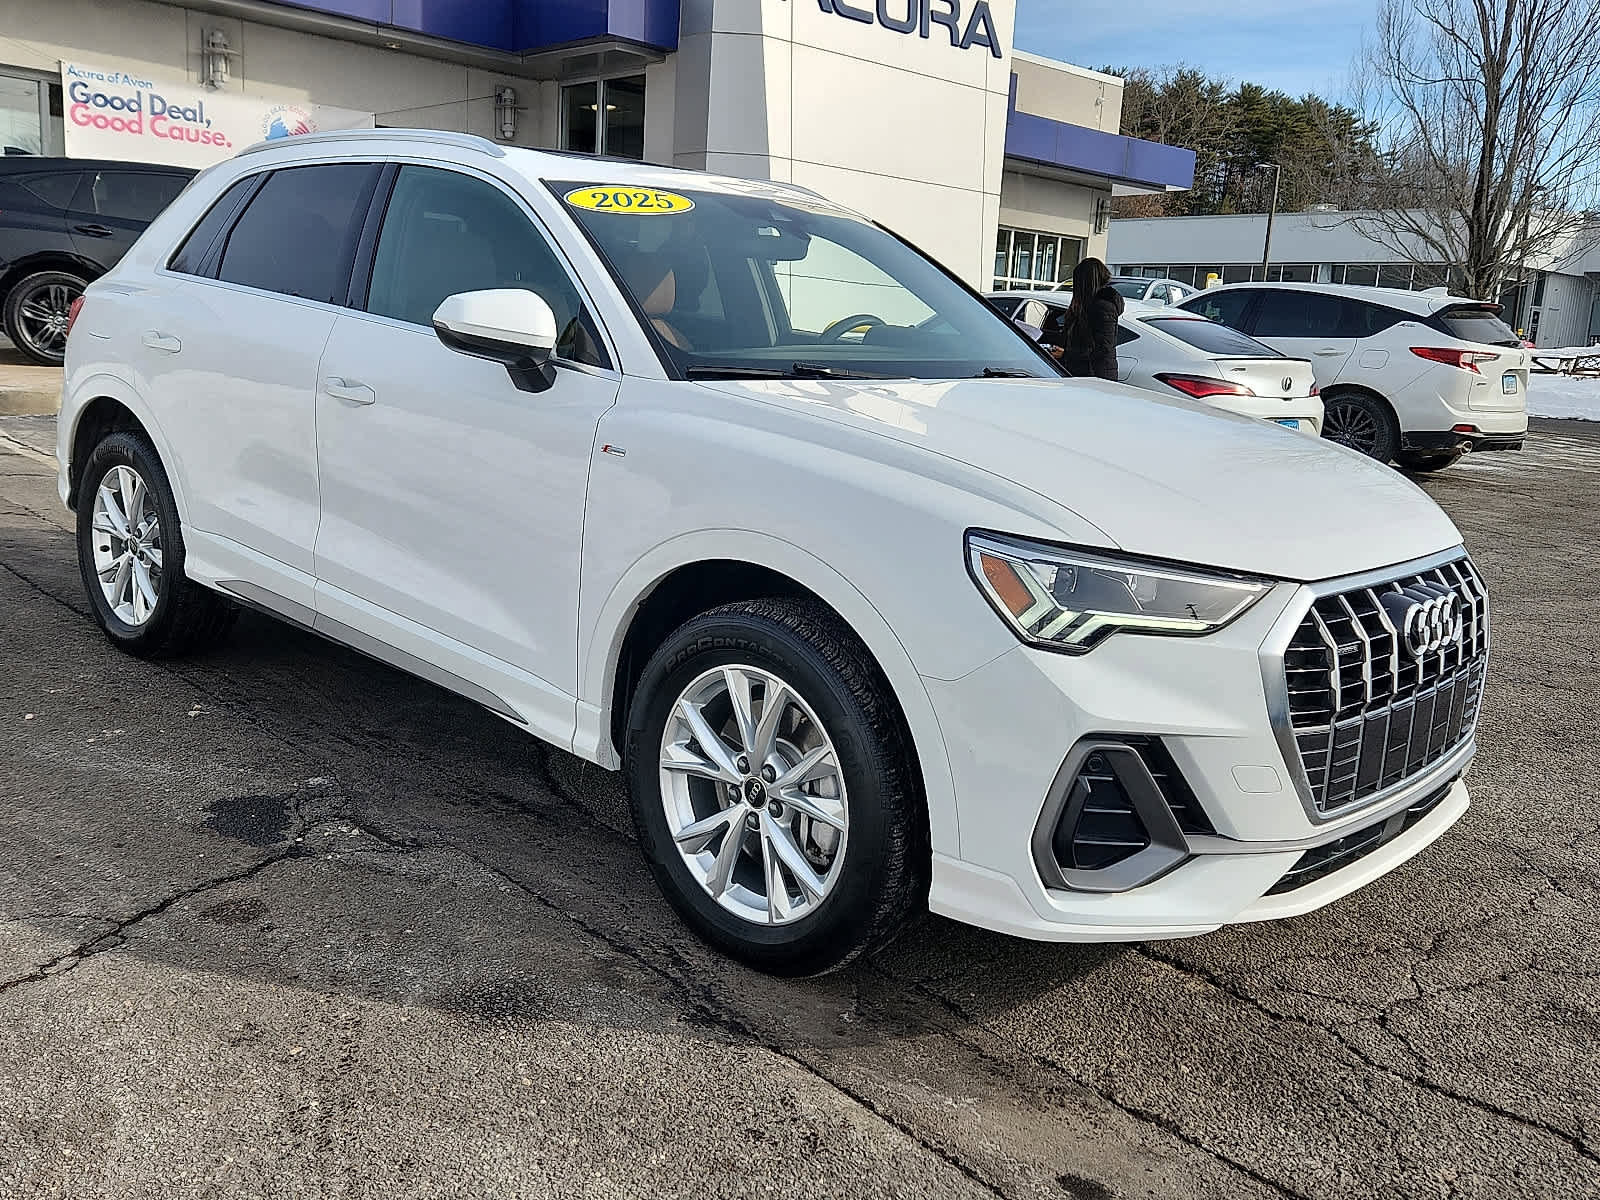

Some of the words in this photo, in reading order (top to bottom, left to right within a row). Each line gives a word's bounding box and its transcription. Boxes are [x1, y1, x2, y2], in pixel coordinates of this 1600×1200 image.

[783, 0, 1002, 58] URA
[66, 64, 105, 82] Acura
[107, 72, 121, 85] of
[121, 72, 153, 89] Avon
[69, 80, 142, 113] Good
[149, 92, 212, 128] Deal,
[70, 102, 143, 135] Good
[150, 115, 233, 149] Cause.
[591, 192, 674, 209] 2025
